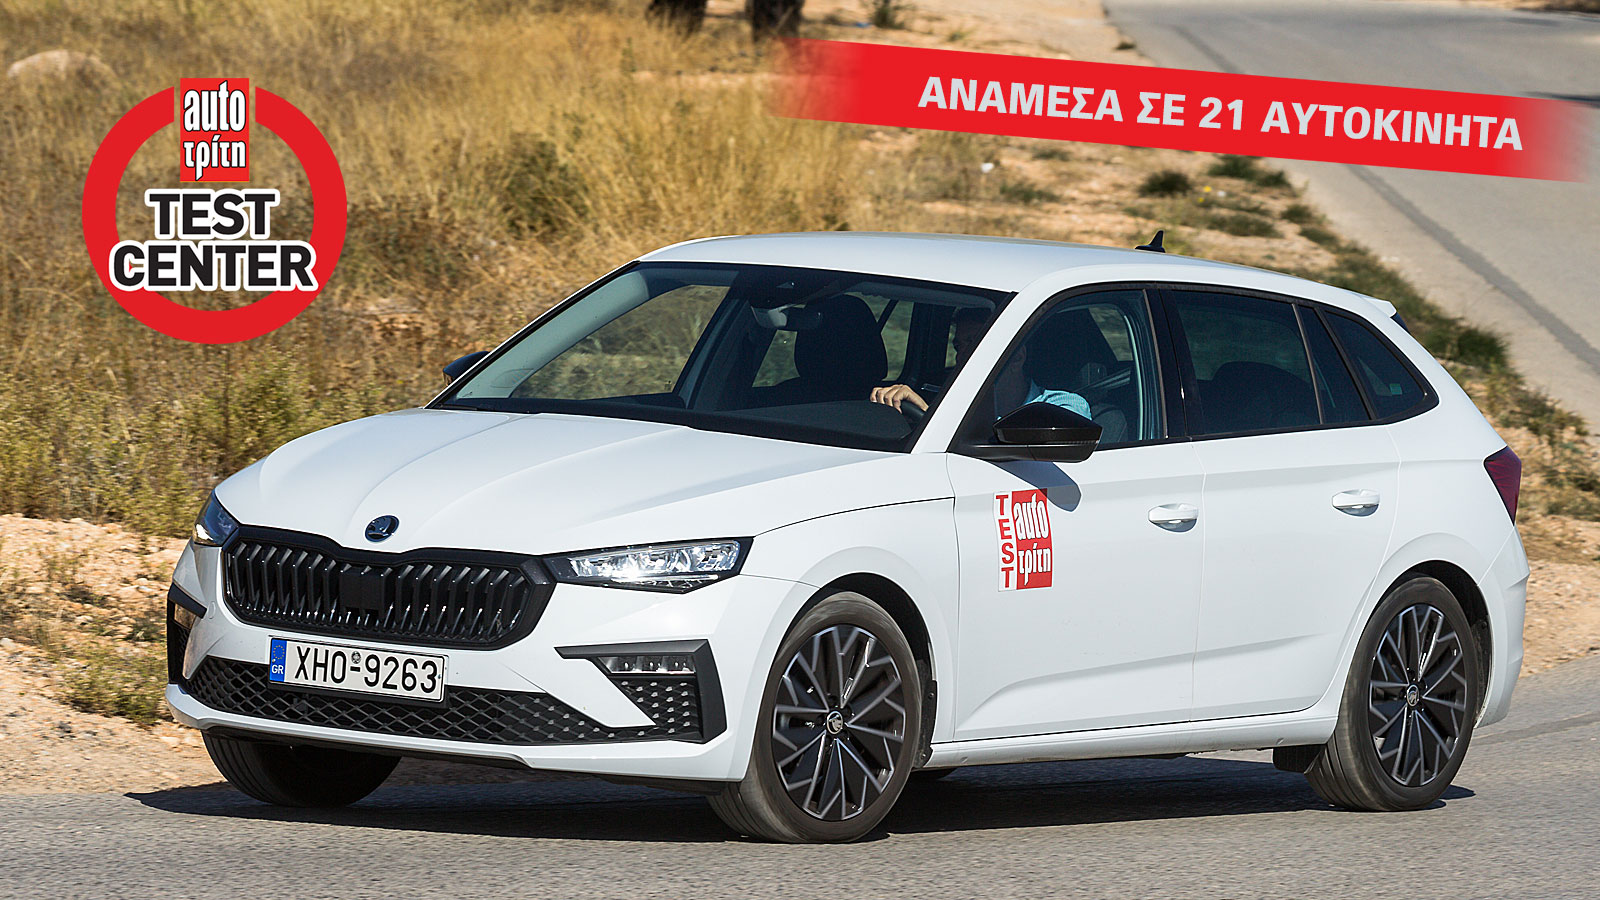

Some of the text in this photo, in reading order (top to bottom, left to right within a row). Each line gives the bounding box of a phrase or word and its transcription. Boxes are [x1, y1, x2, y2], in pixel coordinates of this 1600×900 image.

[1013, 492, 1050, 540] auto
[995, 494, 1014, 588] TEST
[271, 664, 284, 675] GR
